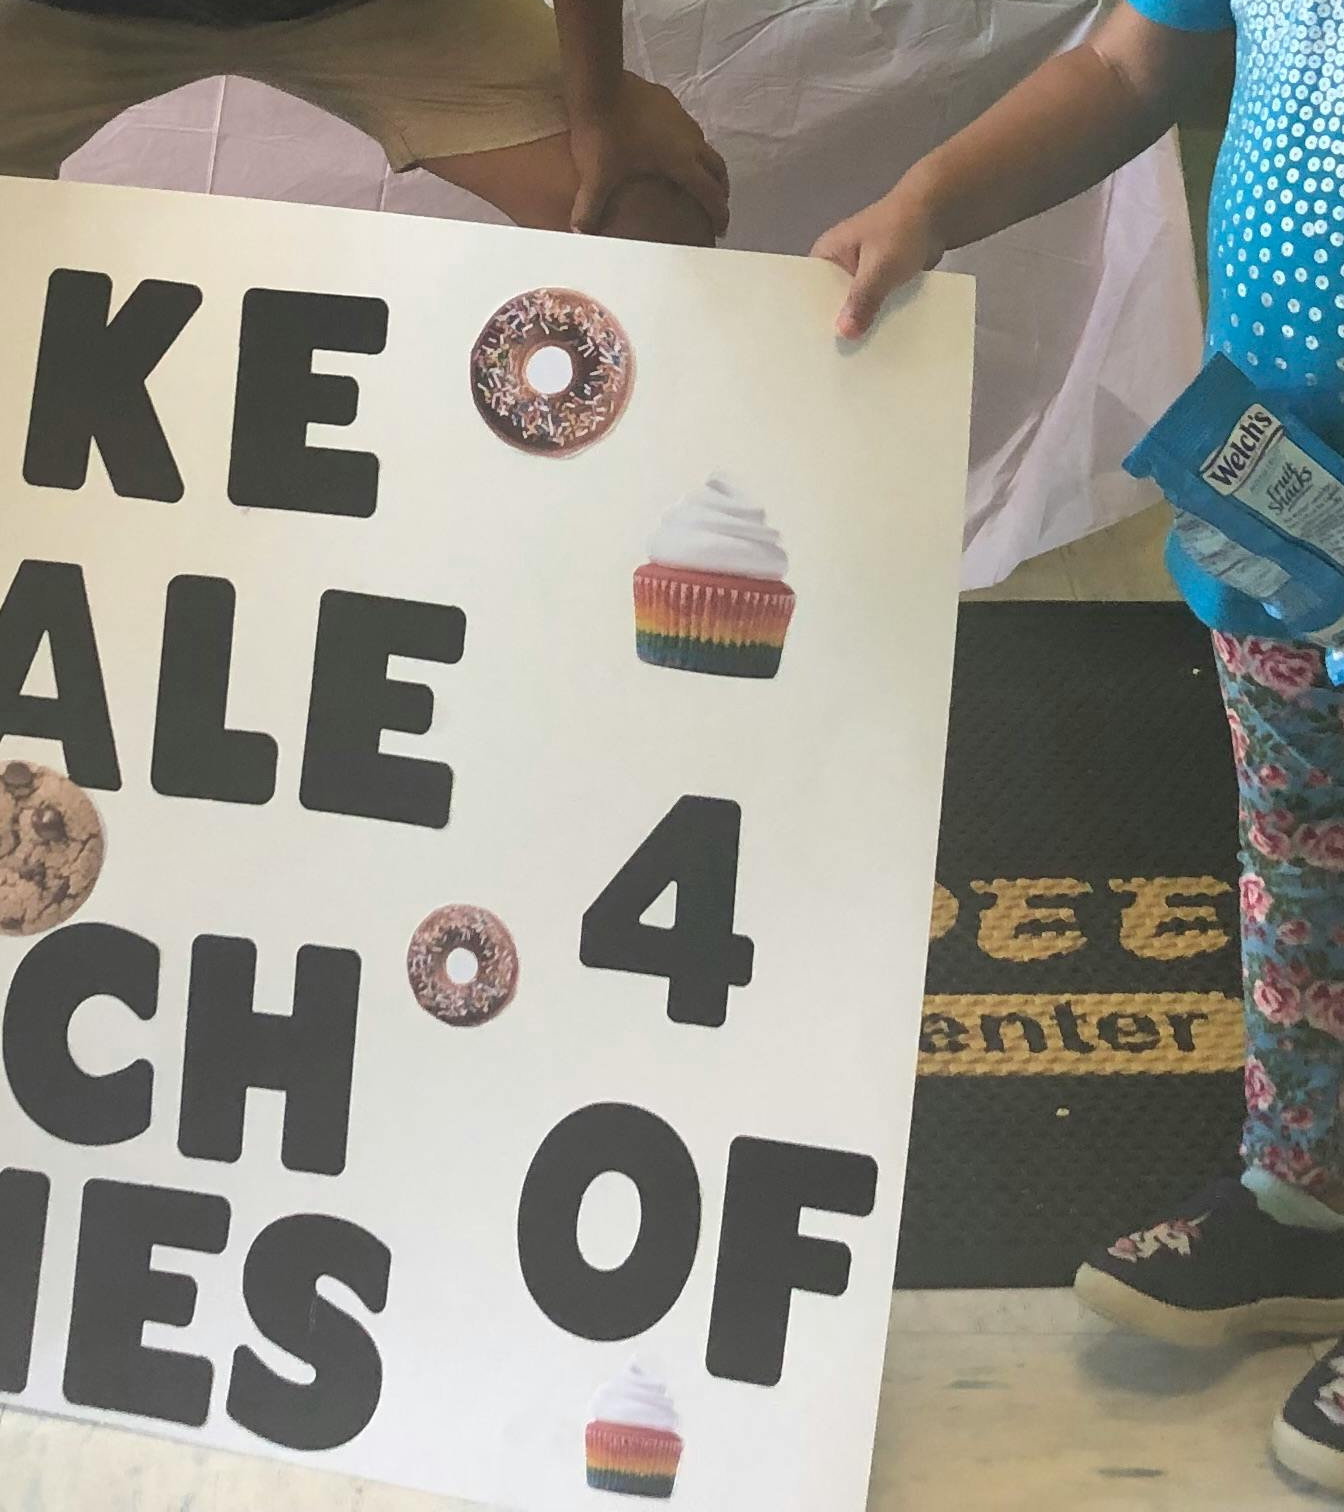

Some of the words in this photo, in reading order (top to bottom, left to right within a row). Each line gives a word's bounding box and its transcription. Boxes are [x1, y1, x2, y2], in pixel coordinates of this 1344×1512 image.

[1209, 410, 1275, 490] Welch's
[1265, 461, 1301, 500] Fruit
[1266, 465, 1313, 513] Snacks
[578, 792, 754, 1028] 4
[928, 874, 1234, 963] EE
[918, 999, 1209, 1055] enter
[517, 1100, 879, 1388] OF
